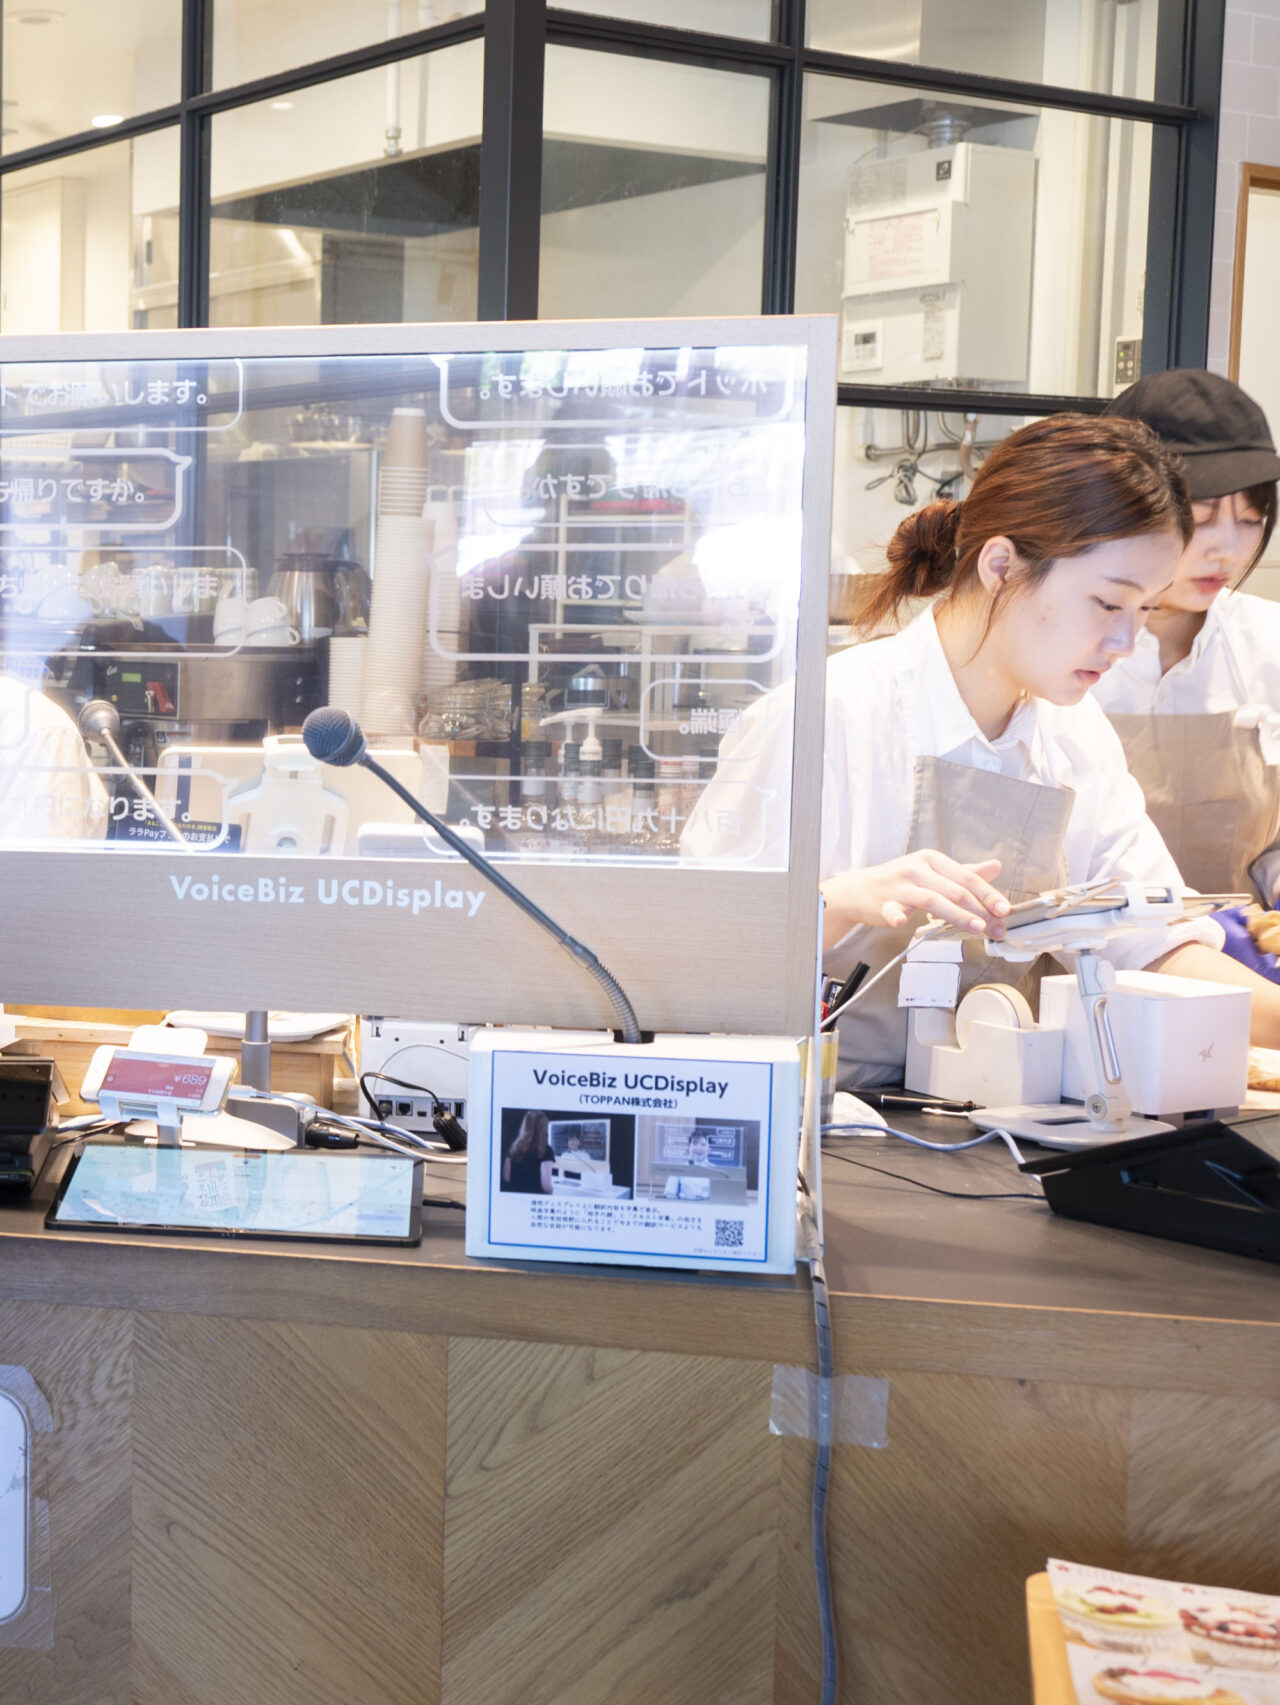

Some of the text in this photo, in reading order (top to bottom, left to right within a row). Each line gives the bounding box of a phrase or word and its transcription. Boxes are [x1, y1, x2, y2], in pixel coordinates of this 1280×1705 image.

[169, 874, 487, 917] VoiceBiz UCDisplay
[533, 1068, 729, 1099] VoiceBiz UCDisplay
